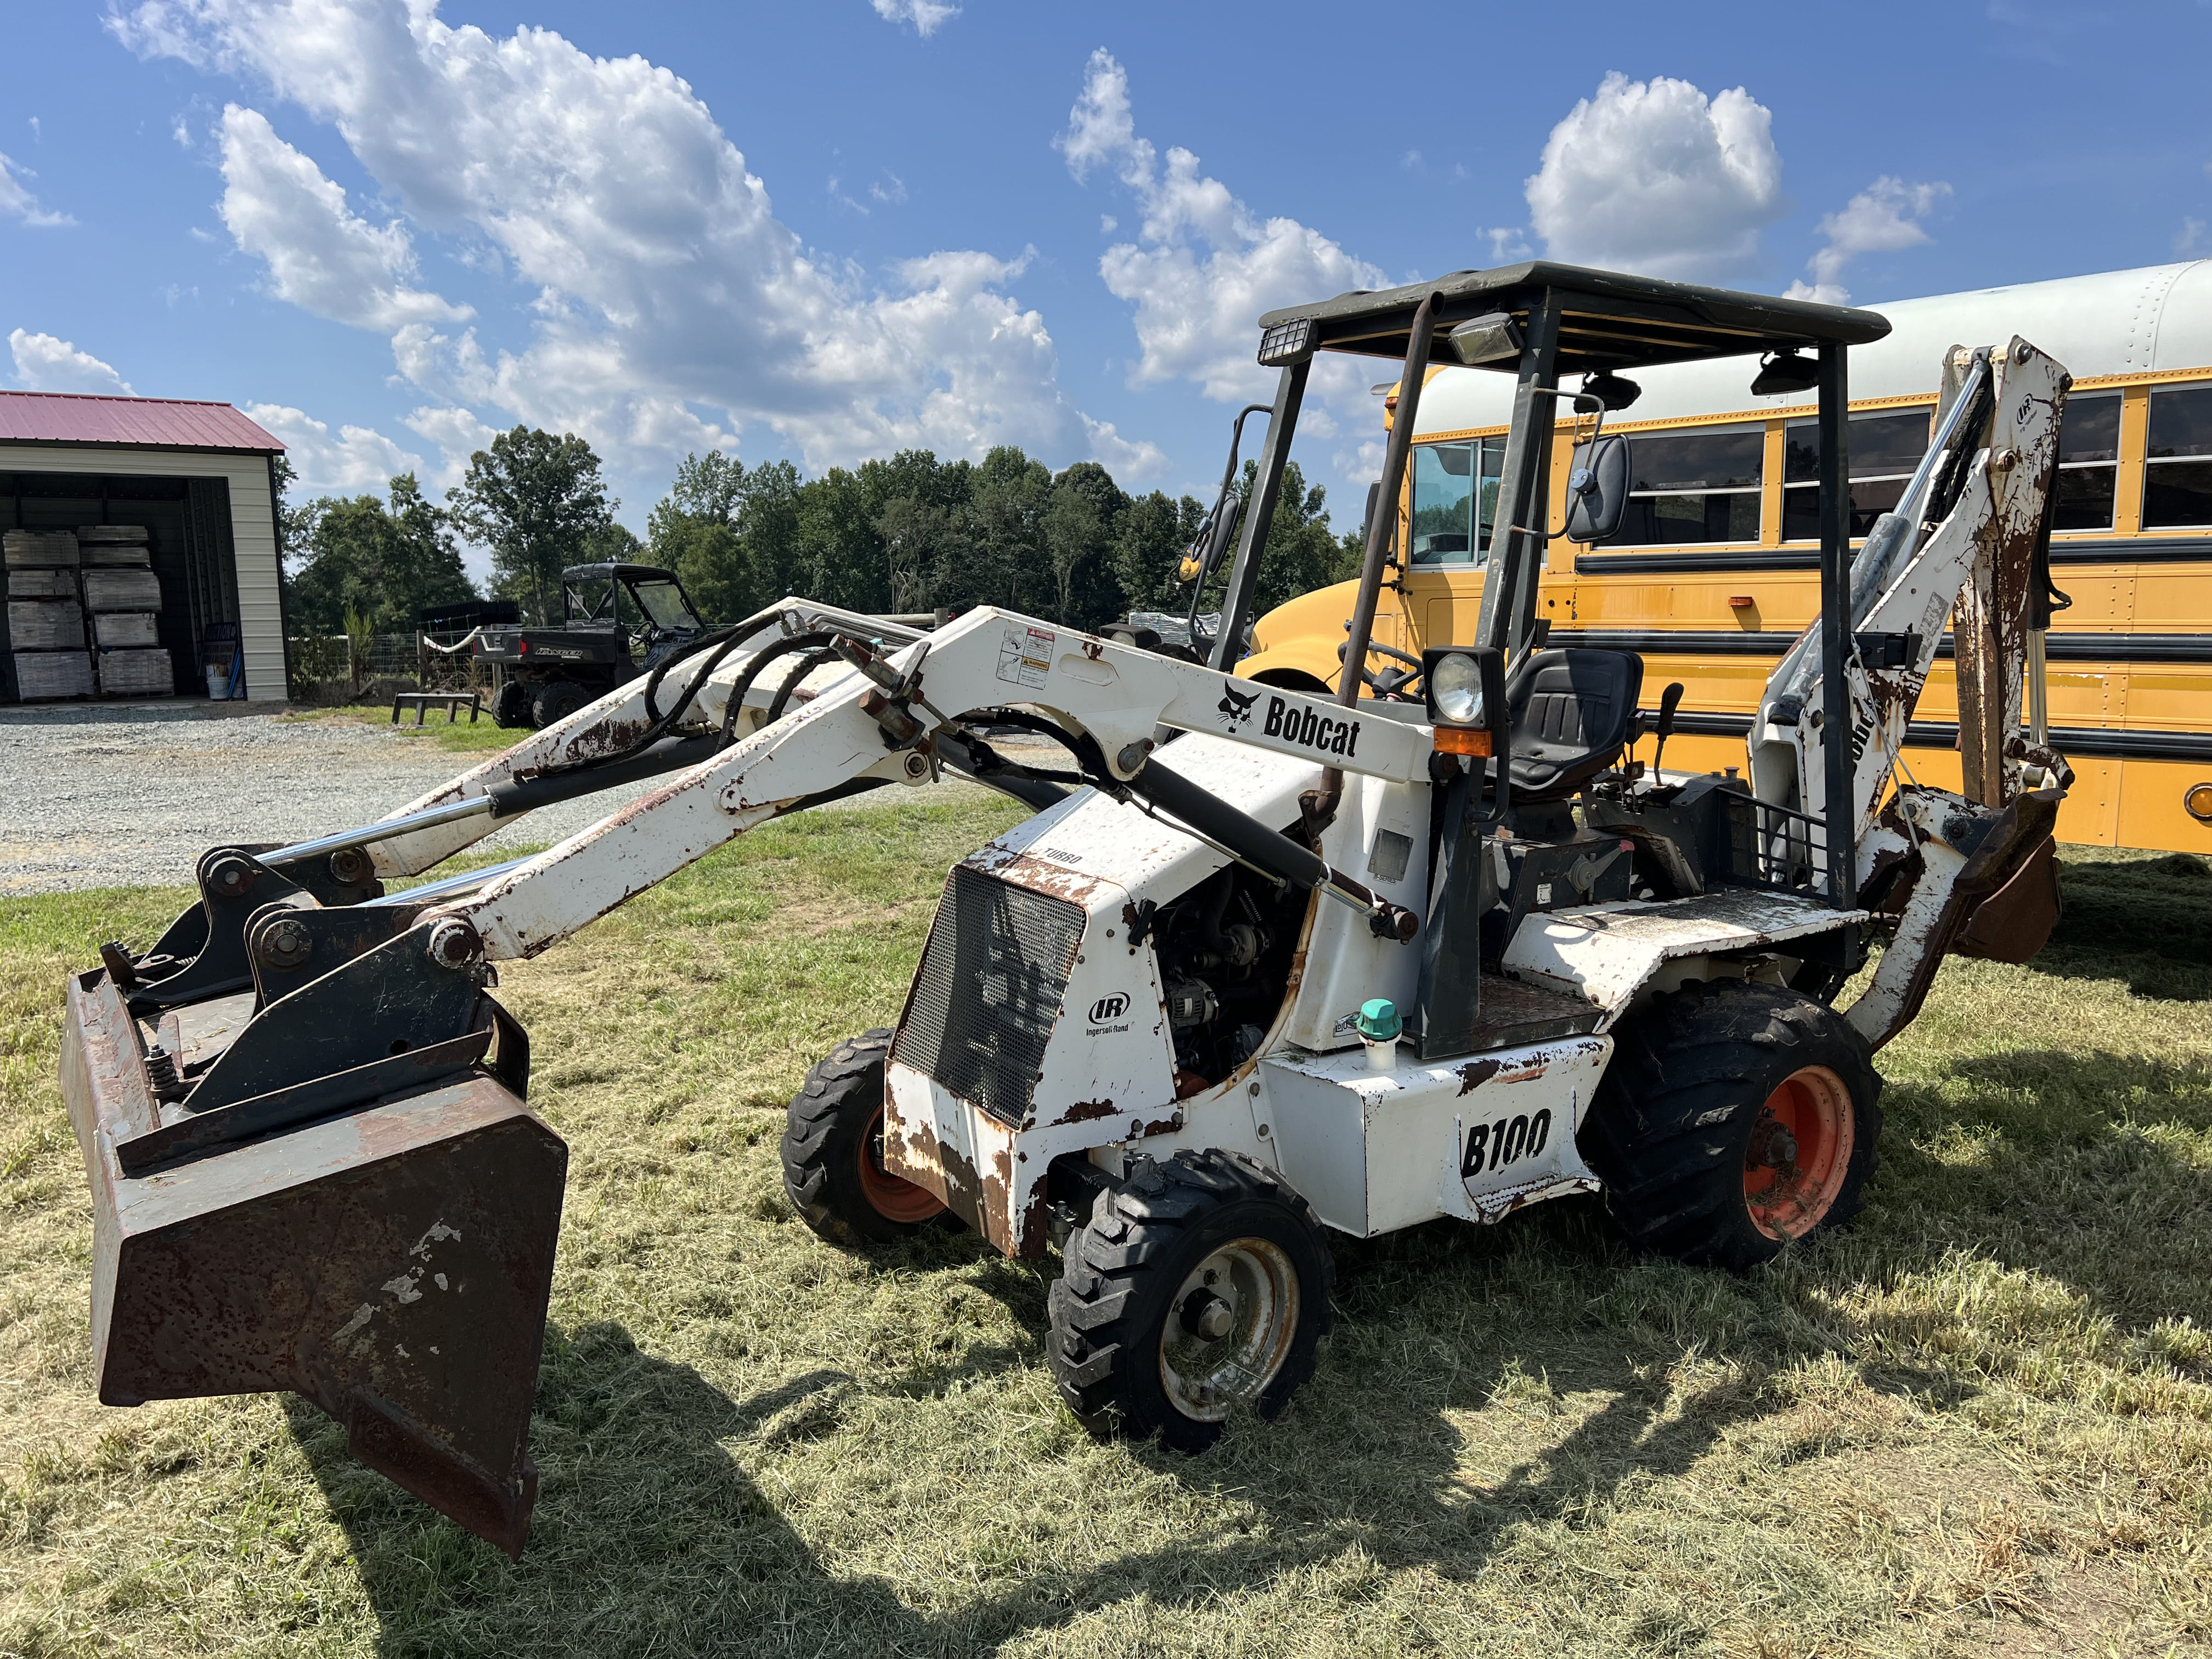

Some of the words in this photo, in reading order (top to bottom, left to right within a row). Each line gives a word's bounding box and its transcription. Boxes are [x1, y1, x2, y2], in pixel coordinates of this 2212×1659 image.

[1029, 660, 1047, 668] WARNING
[1264, 696, 1360, 758] Bobcat
[1045, 848, 1084, 864] TURBO
[1095, 997, 1124, 1019] IR
[1462, 1108, 1551, 1178] B100
